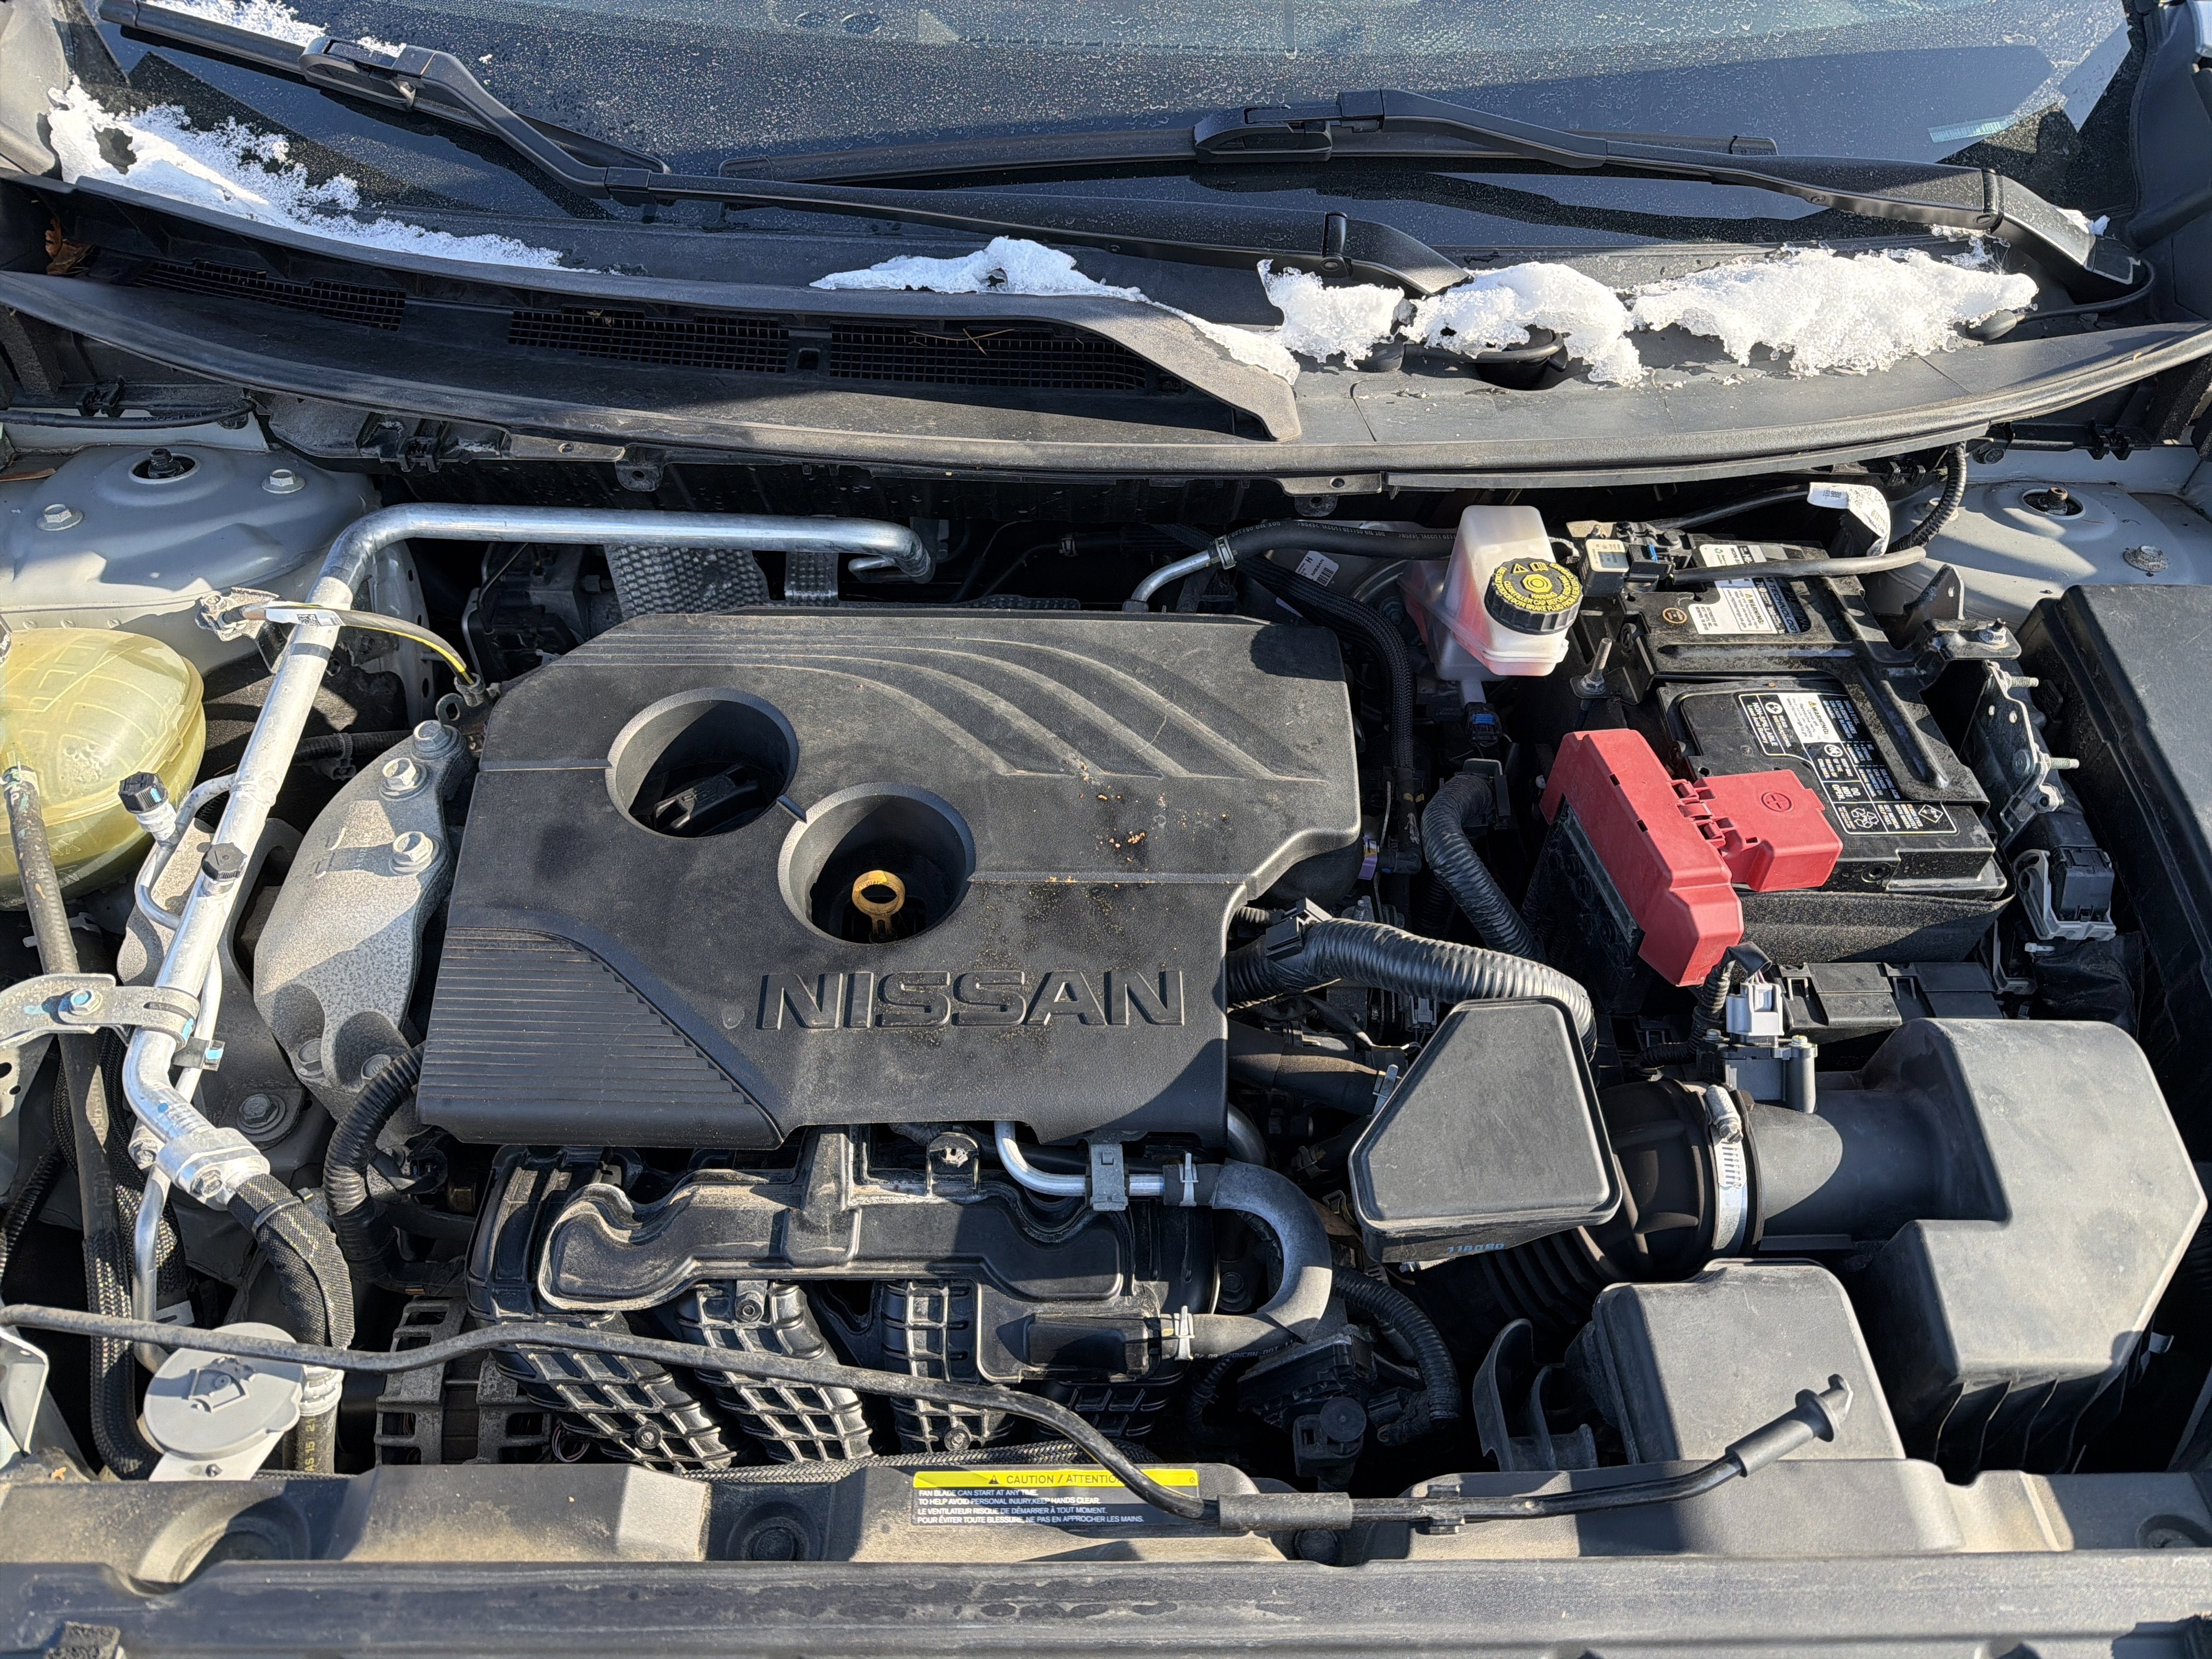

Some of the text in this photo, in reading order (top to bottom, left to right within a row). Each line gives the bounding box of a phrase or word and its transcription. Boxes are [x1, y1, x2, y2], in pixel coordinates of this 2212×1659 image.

[1310, 558, 1324, 576] NISSAN
[1515, 592, 1534, 605] FILLER
[1546, 595, 1567, 606] BEFORE
[1531, 591, 1558, 600] WARNING
[1526, 603, 1547, 612] BRAKE
[1547, 603, 1564, 612] FLUID
[1562, 596, 1576, 608] FROM
[1832, 708, 1843, 719] CAUSE
[1835, 700, 1857, 733] EXPLOSIVE GASES
[1745, 704, 1770, 743] Lead Acid Battery
[1751, 702, 1779, 746] NON-SPILLABLE
[1771, 715, 1792, 748] INSTRUCTIONS.
[1853, 747, 1866, 761] FLAMES
[1839, 758, 1849, 768] KEEP
[1877, 777, 1887, 789] CAUSE
[1879, 769, 1900, 799] SULFURIC ACID
[1831, 784, 1847, 800] OPEN.
[1840, 786, 1853, 798] NOT
[1877, 804, 1887, 815] HELP
[1894, 804, 1904, 814] WITH
[1914, 817, 1923, 827] EYES
[756, 969, 1185, 1031] NISSAN
[304, 1441, 315, 1455] 15
[1006, 1475, 1054, 1484] CAUTION
[1066, 1474, 1120, 1483] ATTENTIO
[1011, 1506, 1049, 1514] DÉMARRER
[1049, 1505, 1056, 1514] À
[938, 1515, 963, 1523] ÉVITER
